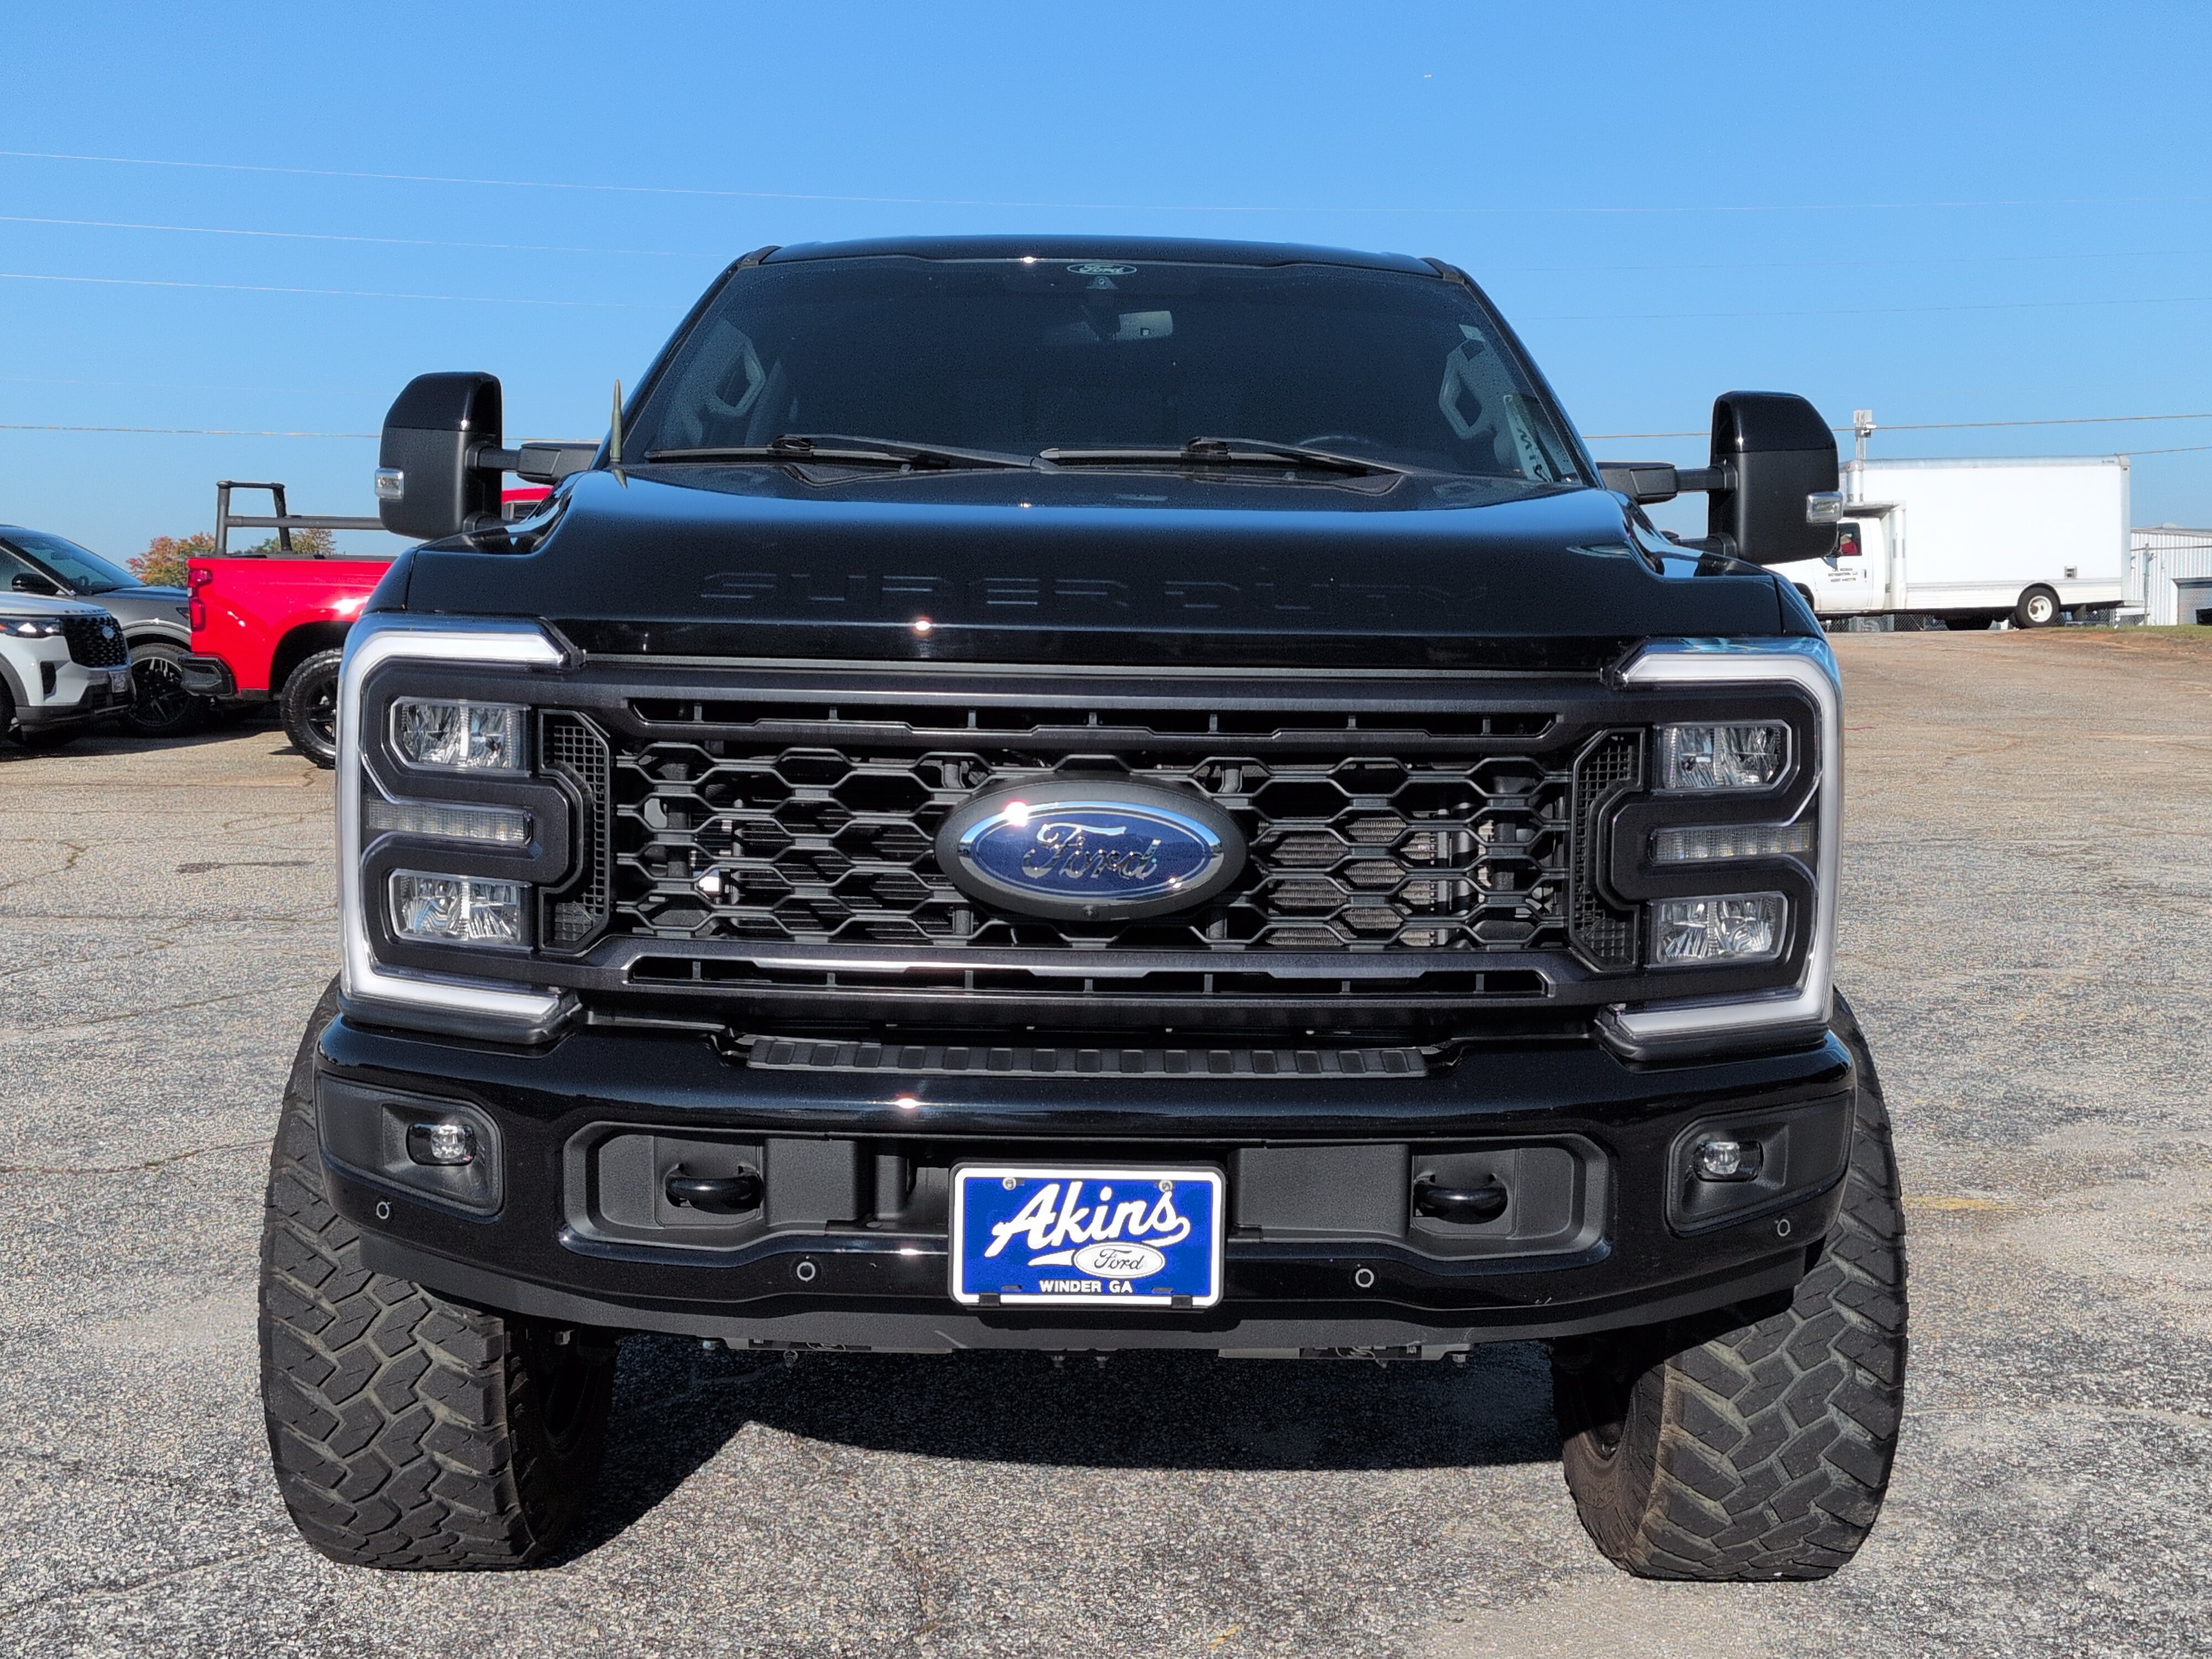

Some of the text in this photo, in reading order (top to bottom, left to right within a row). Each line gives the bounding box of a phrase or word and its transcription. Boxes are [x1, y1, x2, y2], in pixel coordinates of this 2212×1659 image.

[1079, 264, 1125, 273] Ford
[1021, 822, 1162, 880] Ford
[983, 1181, 1191, 1259] Akins
[1093, 1248, 1146, 1270] Ford
[1039, 1280, 1134, 1294] WINDER GA
